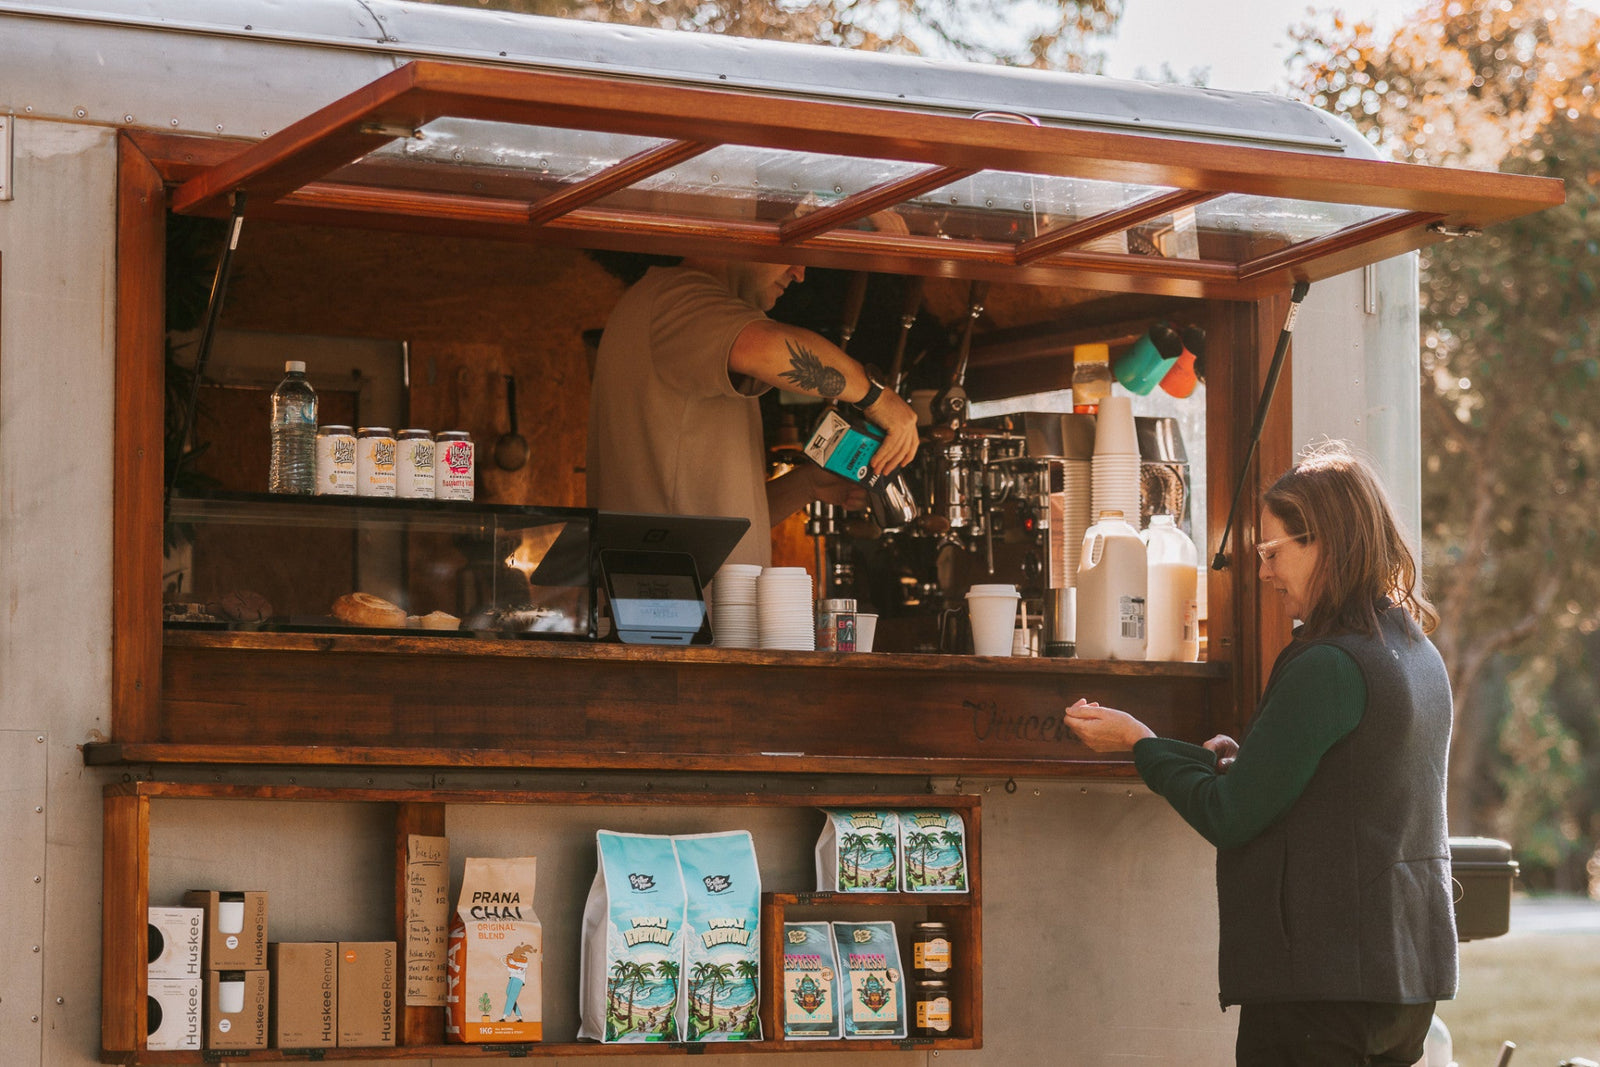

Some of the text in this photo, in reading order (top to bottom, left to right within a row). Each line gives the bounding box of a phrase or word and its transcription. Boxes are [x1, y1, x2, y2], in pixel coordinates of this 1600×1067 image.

[470, 905, 523, 920] CHAI
[472, 891, 520, 903] PRANA
[477, 923, 516, 931] ORIGINAL
[187, 914, 200, 974] Huskee.
[255, 896, 264, 966] HuskeeSteel
[478, 932, 505, 940] BLEND
[849, 953, 887, 971] ESPRESSO
[186, 984, 198, 1045] Huskee.
[256, 976, 265, 1045] HuskeeSteel
[322, 948, 333, 1042] HuskeeRenew
[381, 948, 392, 1042] HuskeeRenew
